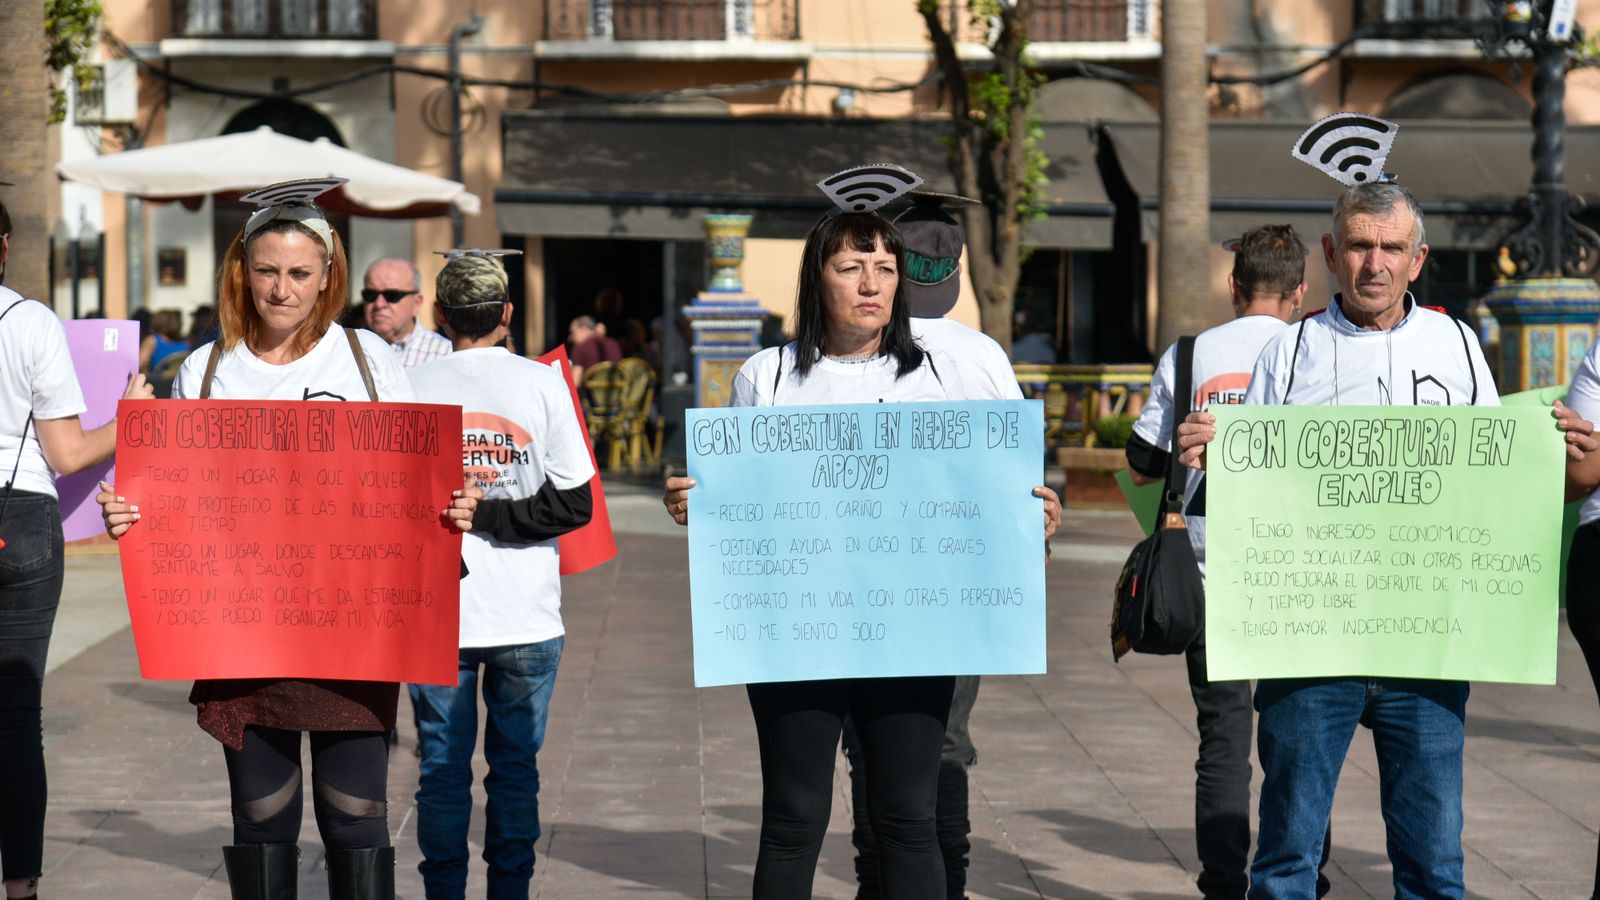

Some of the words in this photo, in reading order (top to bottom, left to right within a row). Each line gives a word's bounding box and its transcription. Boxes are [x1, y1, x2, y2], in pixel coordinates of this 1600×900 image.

[124, 410, 167, 448] CON
[176, 407, 299, 451] COBERTURA
[307, 409, 335, 452] EN
[693, 416, 741, 455] CON
[752, 412, 863, 453] COBERTURA
[875, 412, 901, 449] EN
[911, 410, 971, 450] REDES
[987, 411, 1019, 449] DE
[494, 434, 513, 446] DE
[1222, 419, 1286, 472] CON
[1297, 418, 1456, 469] COBERTURA
[1468, 418, 1516, 466] EN
[145, 465, 189, 483] TENGO
[201, 467, 220, 482] UN
[236, 468, 278, 486] HOGAR
[289, 469, 303, 486] AL
[316, 469, 344, 487] QUE
[359, 471, 408, 489] VOLVER
[812, 455, 889, 490] APOYO
[489, 479, 518, 488] FUERA
[1317, 470, 1442, 507] EMPLEO
[149, 495, 187, 512] ESTOY
[199, 497, 271, 514] PROTEGIDO
[285, 499, 303, 516] DE
[312, 501, 337, 516] LAS
[352, 502, 438, 524] INCLEMENCIAS
[835, 499, 883, 520] CARIÑO
[899, 500, 908, 519] Y
[149, 515, 173, 533] DEL
[188, 516, 236, 533] TIEMPO
[1306, 523, 1376, 540] INGRESOS
[149, 543, 192, 559] TENGO
[200, 544, 217, 560] UN
[225, 542, 264, 560] LUGAR
[275, 543, 317, 561] DONDE
[330, 544, 404, 560] DESCANSAR
[416, 543, 424, 561] Y
[789, 538, 833, 555] AYUDA
[846, 536, 860, 553] EN
[868, 535, 900, 553] CASO
[911, 536, 928, 554] DE
[938, 537, 987, 555] GRAVES
[151, 560, 220, 576] SENTIRME
[233, 562, 243, 576] A
[255, 562, 305, 578] SALVO
[722, 558, 809, 576] NECESIDADES
[1302, 549, 1382, 566] SOCIALIZAR
[1391, 551, 1416, 566] CON
[1423, 552, 1462, 569] OTRAS
[1471, 551, 1542, 573] PERSONAS
[1244, 570, 1280, 588] PUEDO
[1284, 571, 1339, 589] MEJORAR
[1345, 572, 1357, 588] EL
[1366, 574, 1423, 591] DISFRUTE
[1433, 576, 1449, 591] DE
[1461, 578, 1479, 593] MI
[1486, 578, 1524, 596] OCIO
[151, 588, 191, 606] TENGO
[199, 588, 217, 605] UN
[229, 587, 264, 604] LUGAR
[274, 588, 300, 605] QUE
[305, 589, 326, 606] ME
[336, 588, 354, 606] DA
[363, 588, 433, 608] ESTABILIDAD
[801, 592, 817, 609] MI
[828, 590, 855, 608] VIDA
[867, 588, 895, 607] CON
[904, 588, 949, 607] OTRAS
[961, 587, 1024, 607] PERSONAS
[1246, 593, 1254, 610] Y
[1267, 595, 1314, 609] TIEMPO
[1323, 593, 1358, 609] LIBRE
[156, 609, 164, 625] Y
[167, 609, 210, 625] DONDE
[221, 608, 262, 624] PUEDO
[274, 608, 338, 627] ORGANIZAR
[346, 610, 363, 625] MI
[374, 609, 405, 628] VIDA
[1242, 621, 1278, 637] TENGO
[1284, 620, 1328, 636] MAYOR
[1342, 617, 1463, 635] INDEPENDENCIA
[759, 624, 779, 641] ME
[792, 621, 838, 641] SIENTO
[852, 622, 886, 641] SOLO
